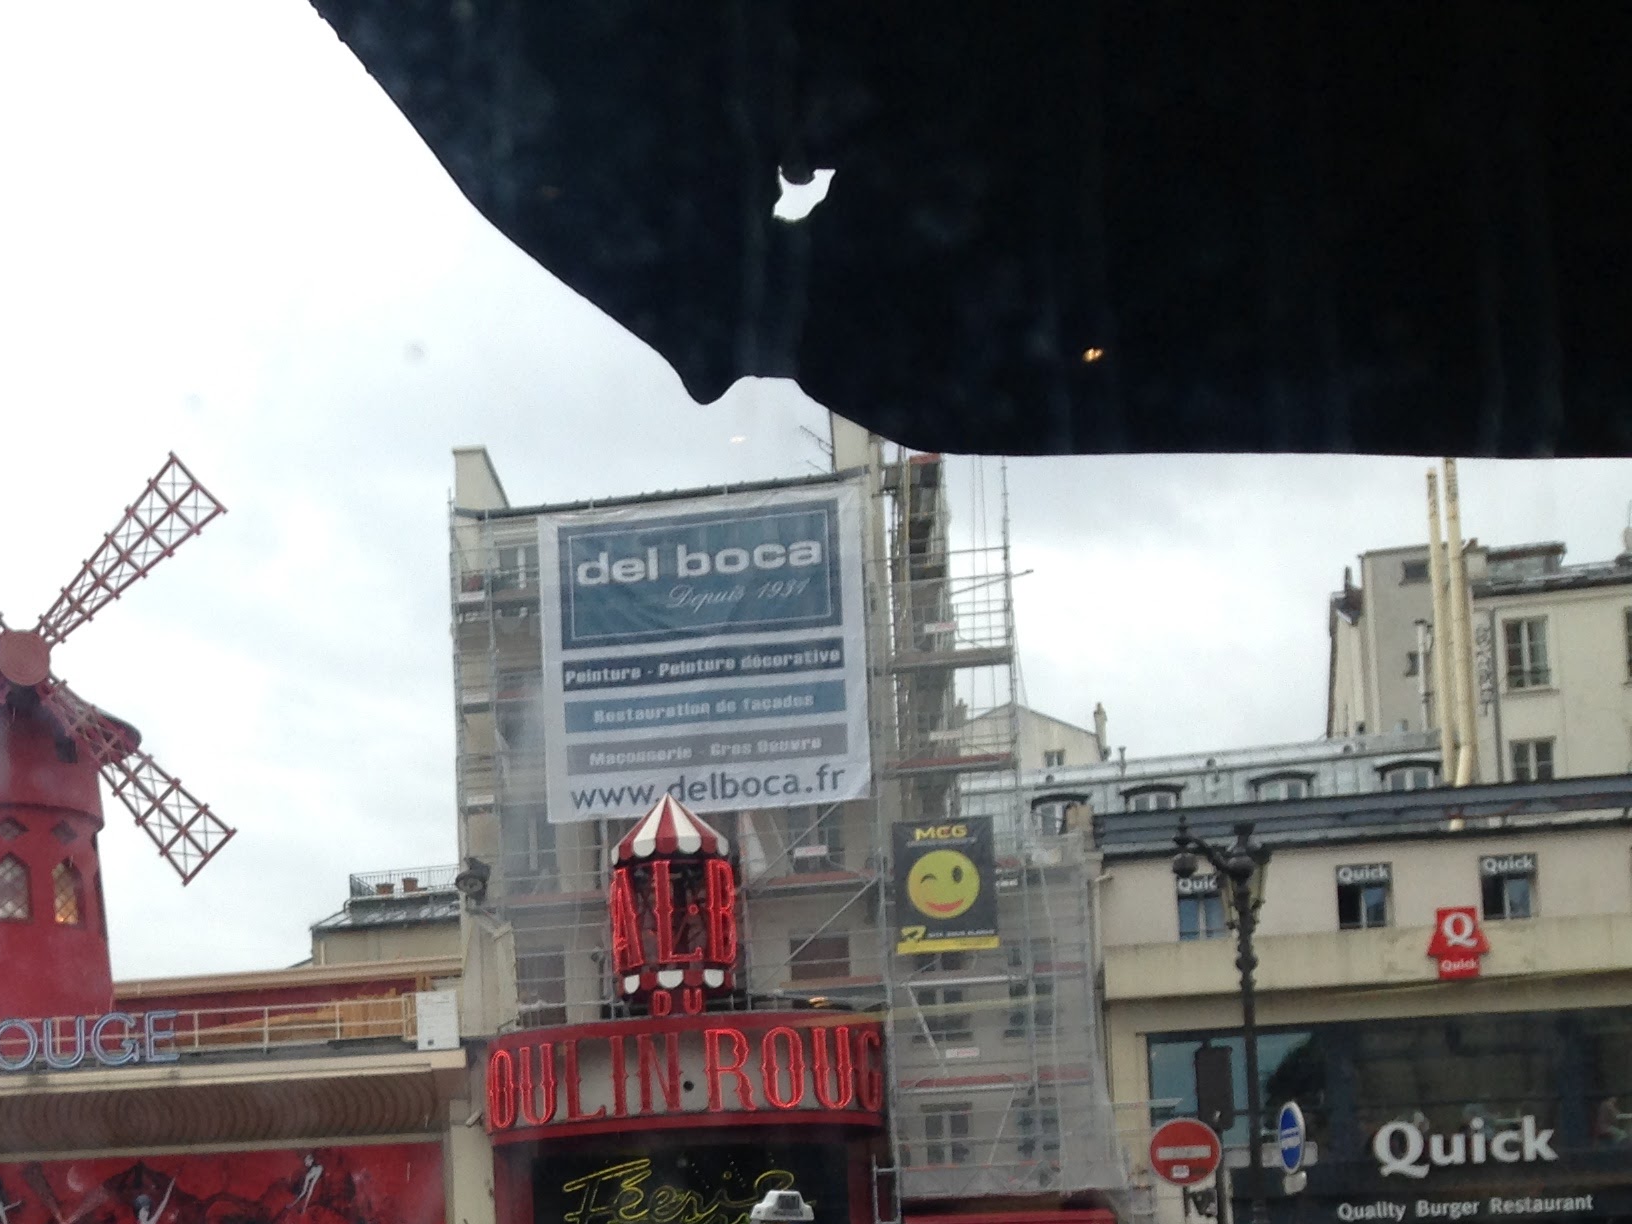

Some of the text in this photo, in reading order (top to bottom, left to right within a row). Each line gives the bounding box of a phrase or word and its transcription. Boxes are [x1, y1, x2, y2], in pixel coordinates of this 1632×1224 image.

[576, 540, 823, 586] del boca
[669, 584, 744, 613] Depuis
[566, 664, 642, 685] Peinture
[658, 654, 736, 678] Peinture
[593, 701, 711, 724] Restauration
[716, 699, 736, 714] de
[570, 763, 846, 811] www.delboca.fr
[915, 825, 968, 841] MCG
[1338, 863, 1388, 883] Quick
[1483, 854, 1534, 873] Quick
[1177, 873, 1218, 893] Quic
[1444, 913, 1478, 948] Q
[653, 988, 703, 1017] DU
[487, 1029, 683, 1130] OULIN
[1372, 1114, 1559, 1179] Quick
[1336, 1194, 1595, 1222] Quality Burger Restaurant
